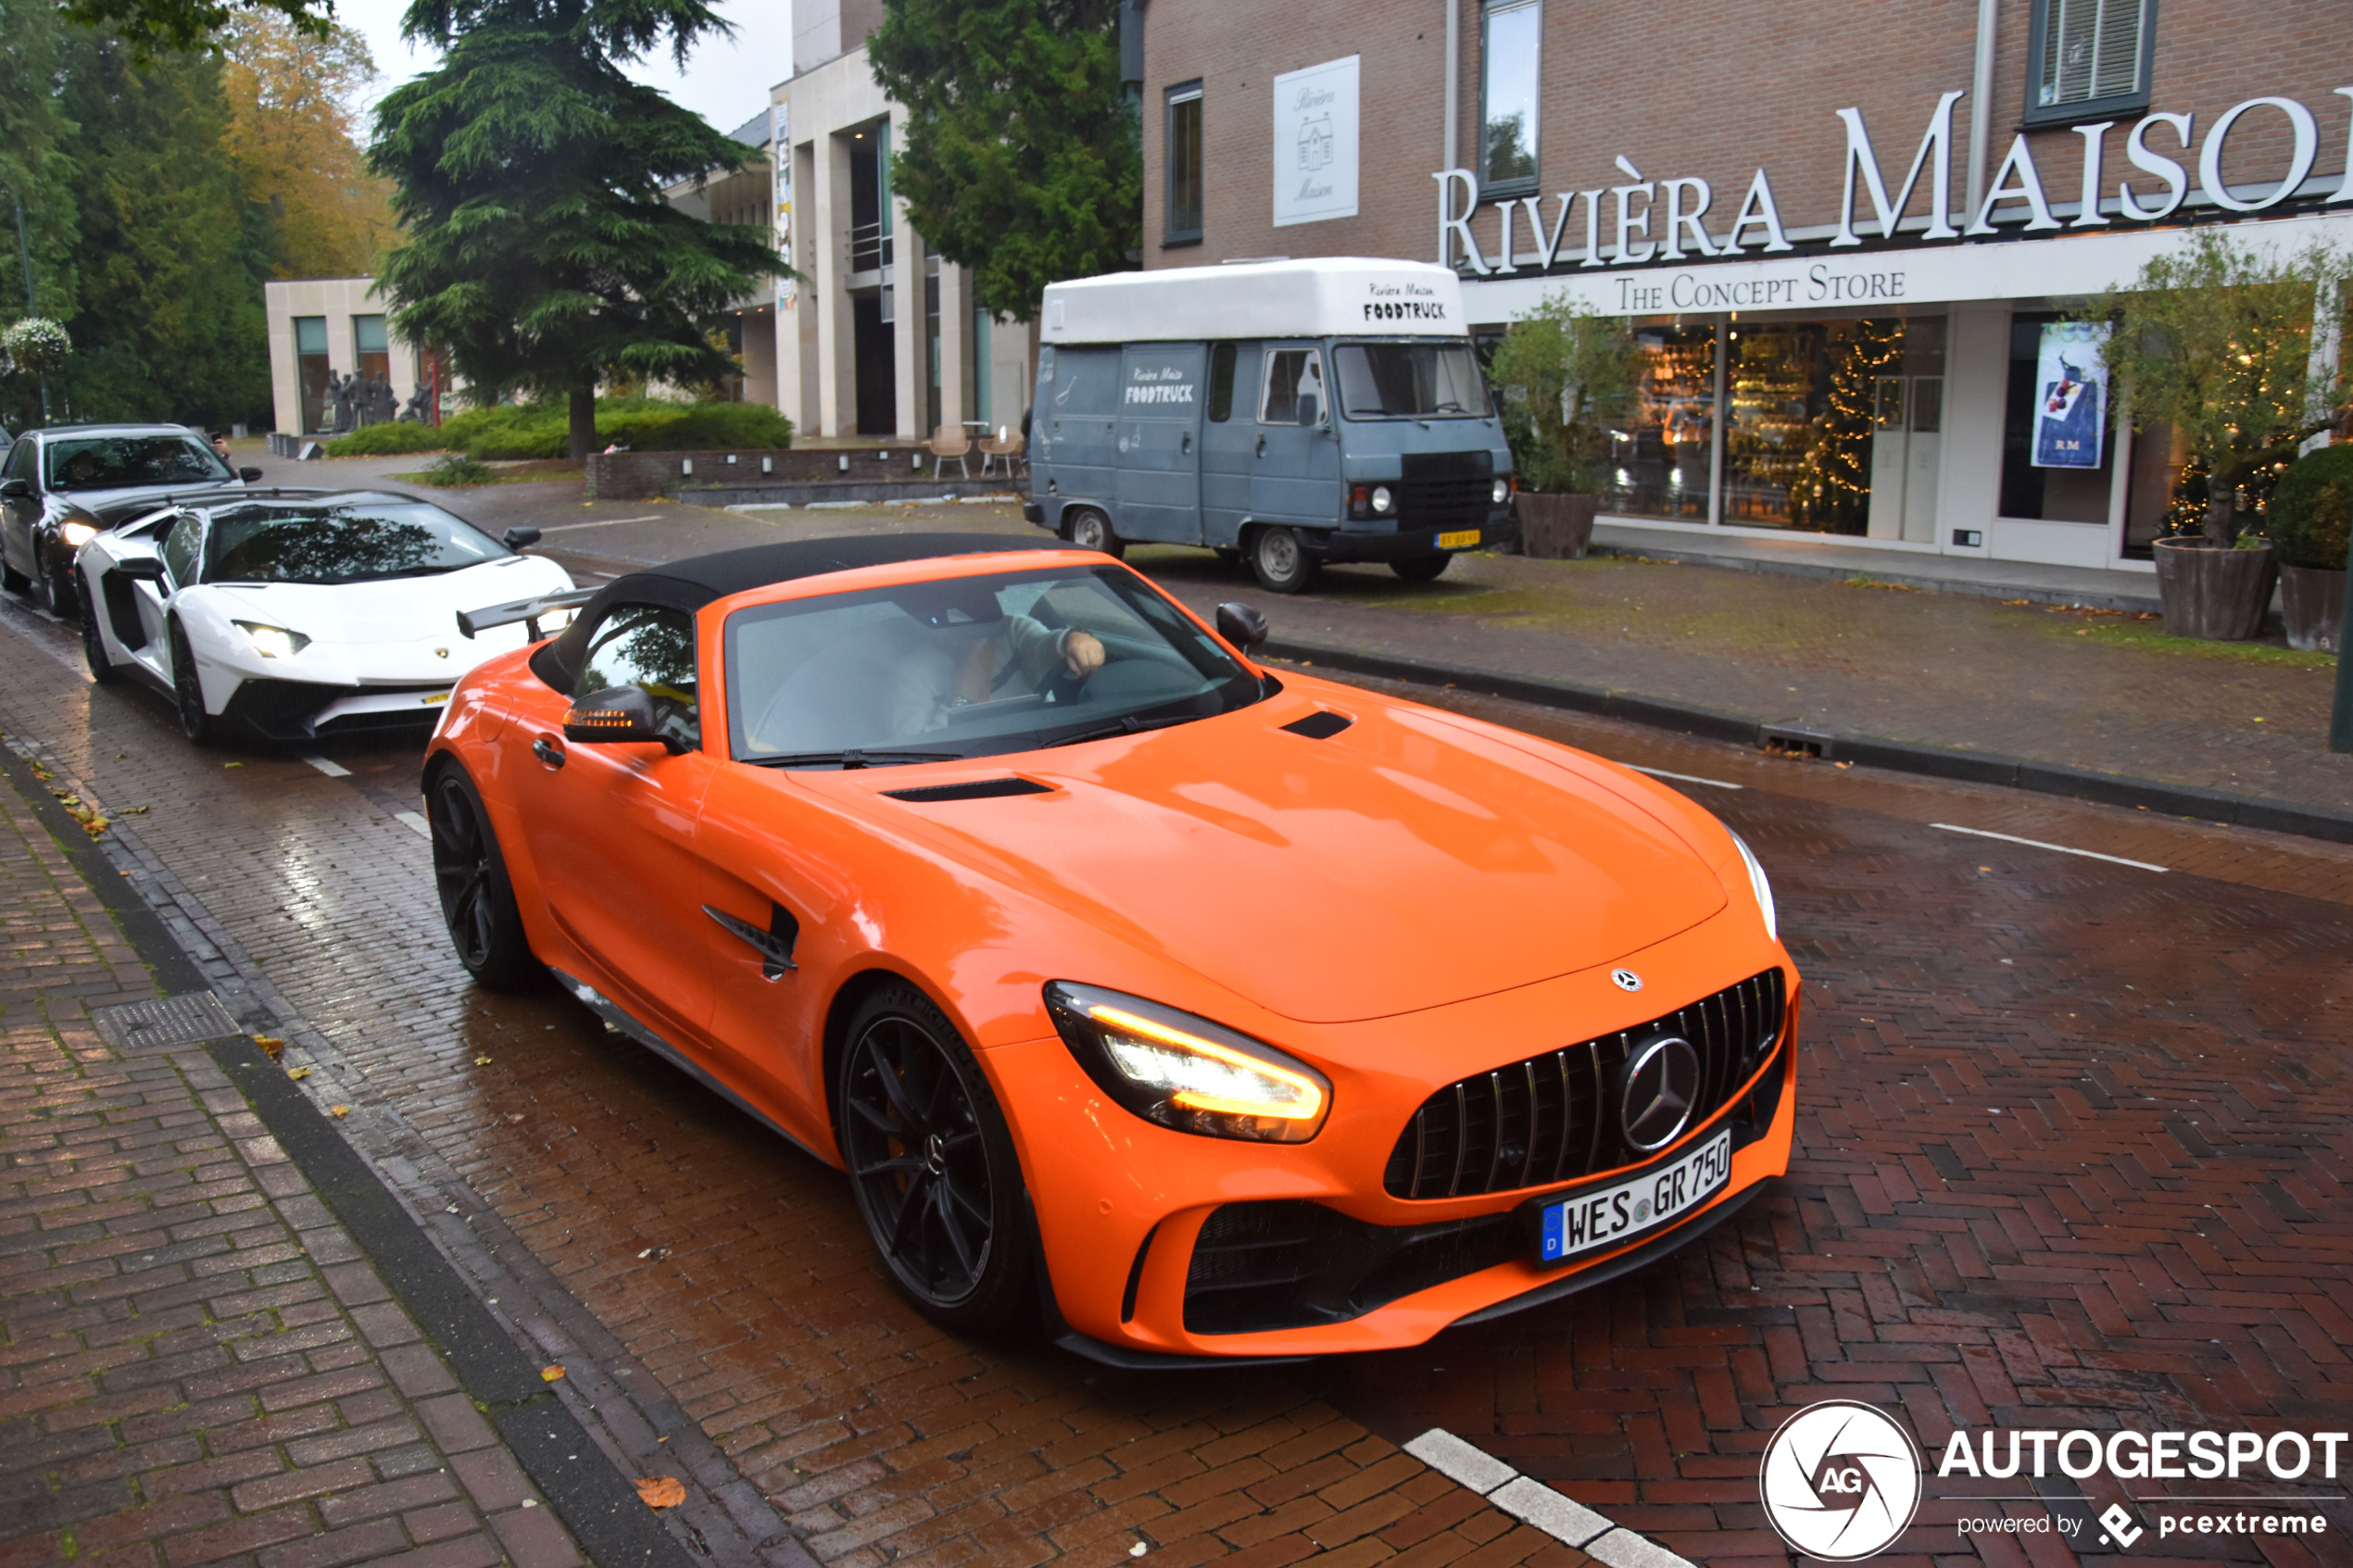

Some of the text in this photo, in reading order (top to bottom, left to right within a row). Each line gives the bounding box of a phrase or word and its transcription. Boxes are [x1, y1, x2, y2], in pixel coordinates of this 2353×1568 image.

[1294, 178, 1333, 201] Maison
[1364, 302, 1446, 320] FOODTRUCK
[1125, 384, 1193, 404] FOODTRUCK
[1567, 1136, 1728, 1248] WES GR 750
[1546, 1237, 1557, 1251] D
